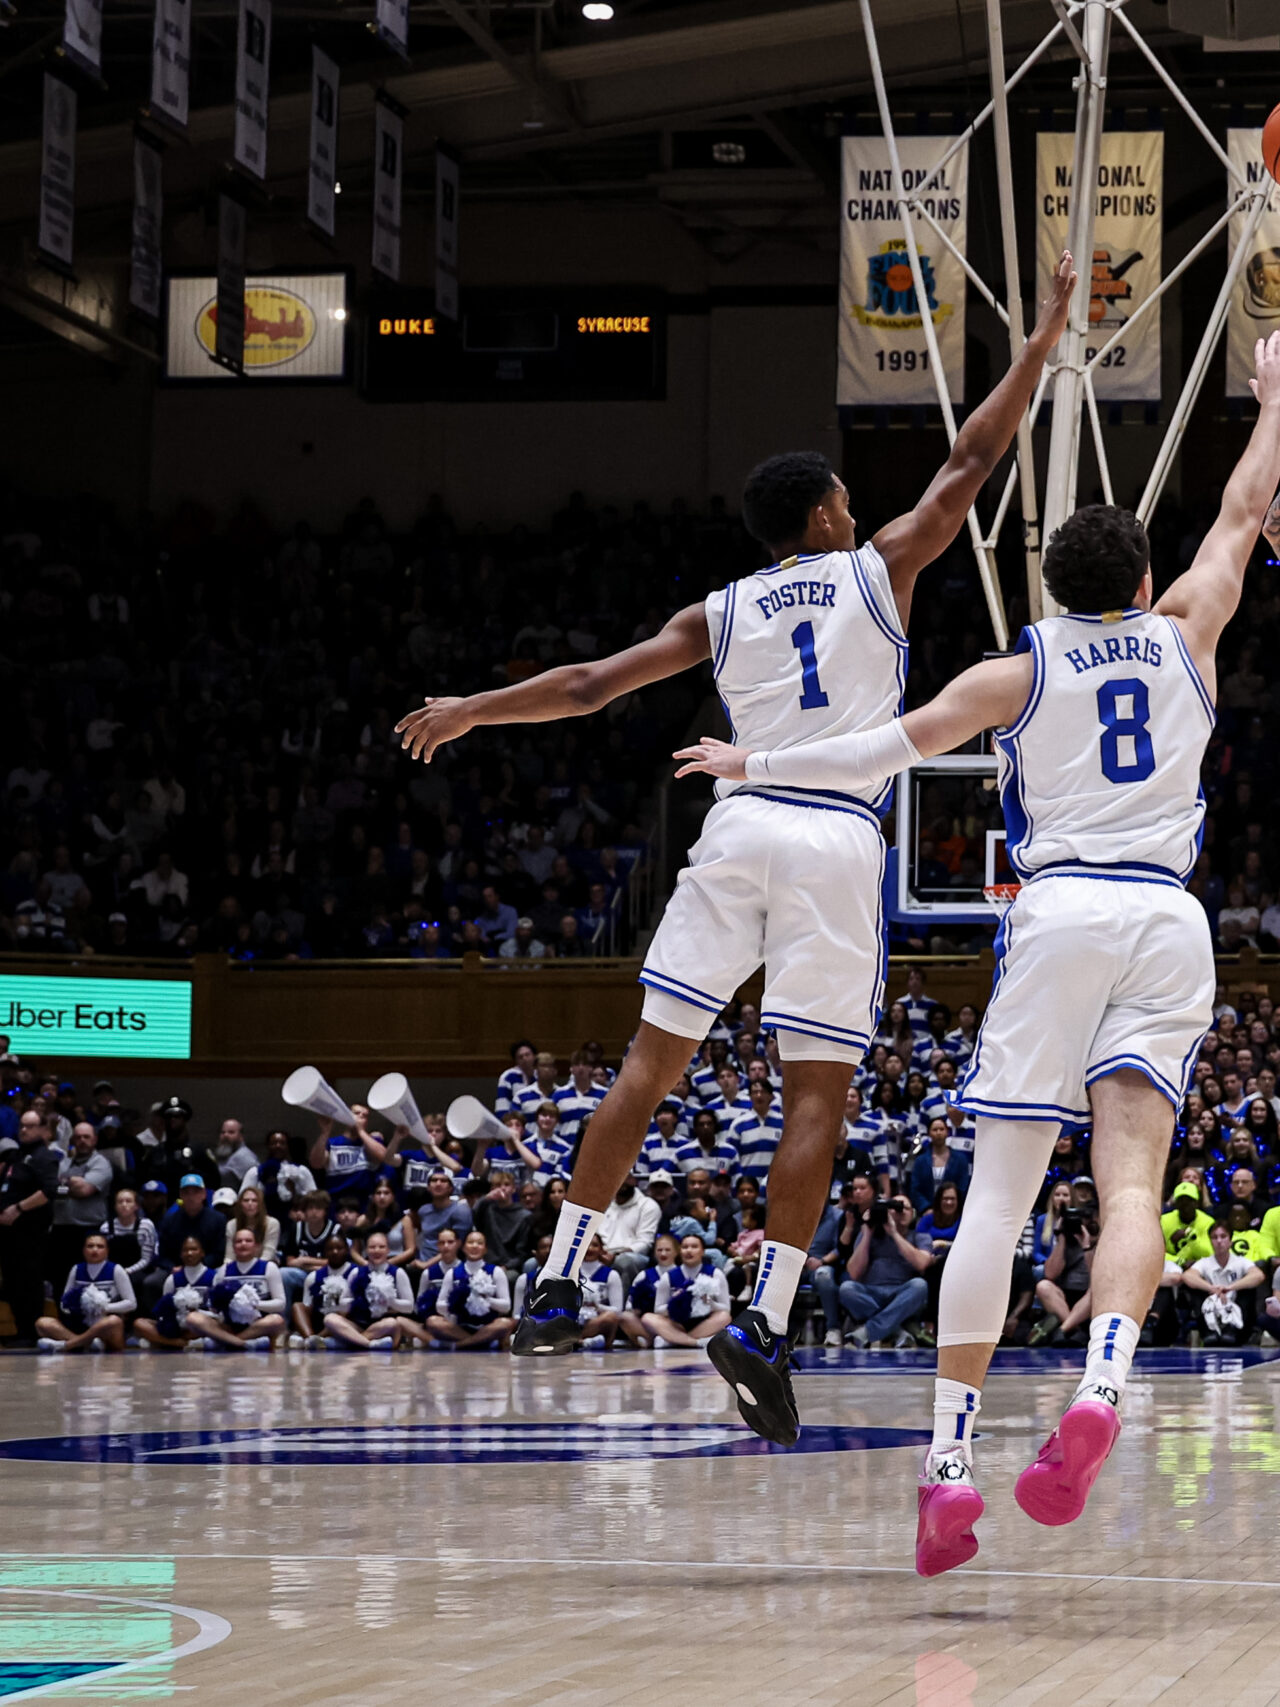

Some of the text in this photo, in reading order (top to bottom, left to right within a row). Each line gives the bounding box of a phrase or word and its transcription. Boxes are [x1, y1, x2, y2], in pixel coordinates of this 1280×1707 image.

[859, 169, 950, 191] NATONAL
[1056, 165, 1145, 187] NONAL
[1044, 194, 1156, 217] CHPIONS
[378, 318, 436, 335] DUKE
[577, 316, 651, 333] SYRACUSE
[875, 349, 930, 371] 1991
[756, 581, 836, 620] FOSTER
[791, 620, 829, 710] 1
[1064, 636, 1162, 674] HARRIS
[1096, 677, 1156, 784] 8
[74, 1004, 147, 1031] Eats
